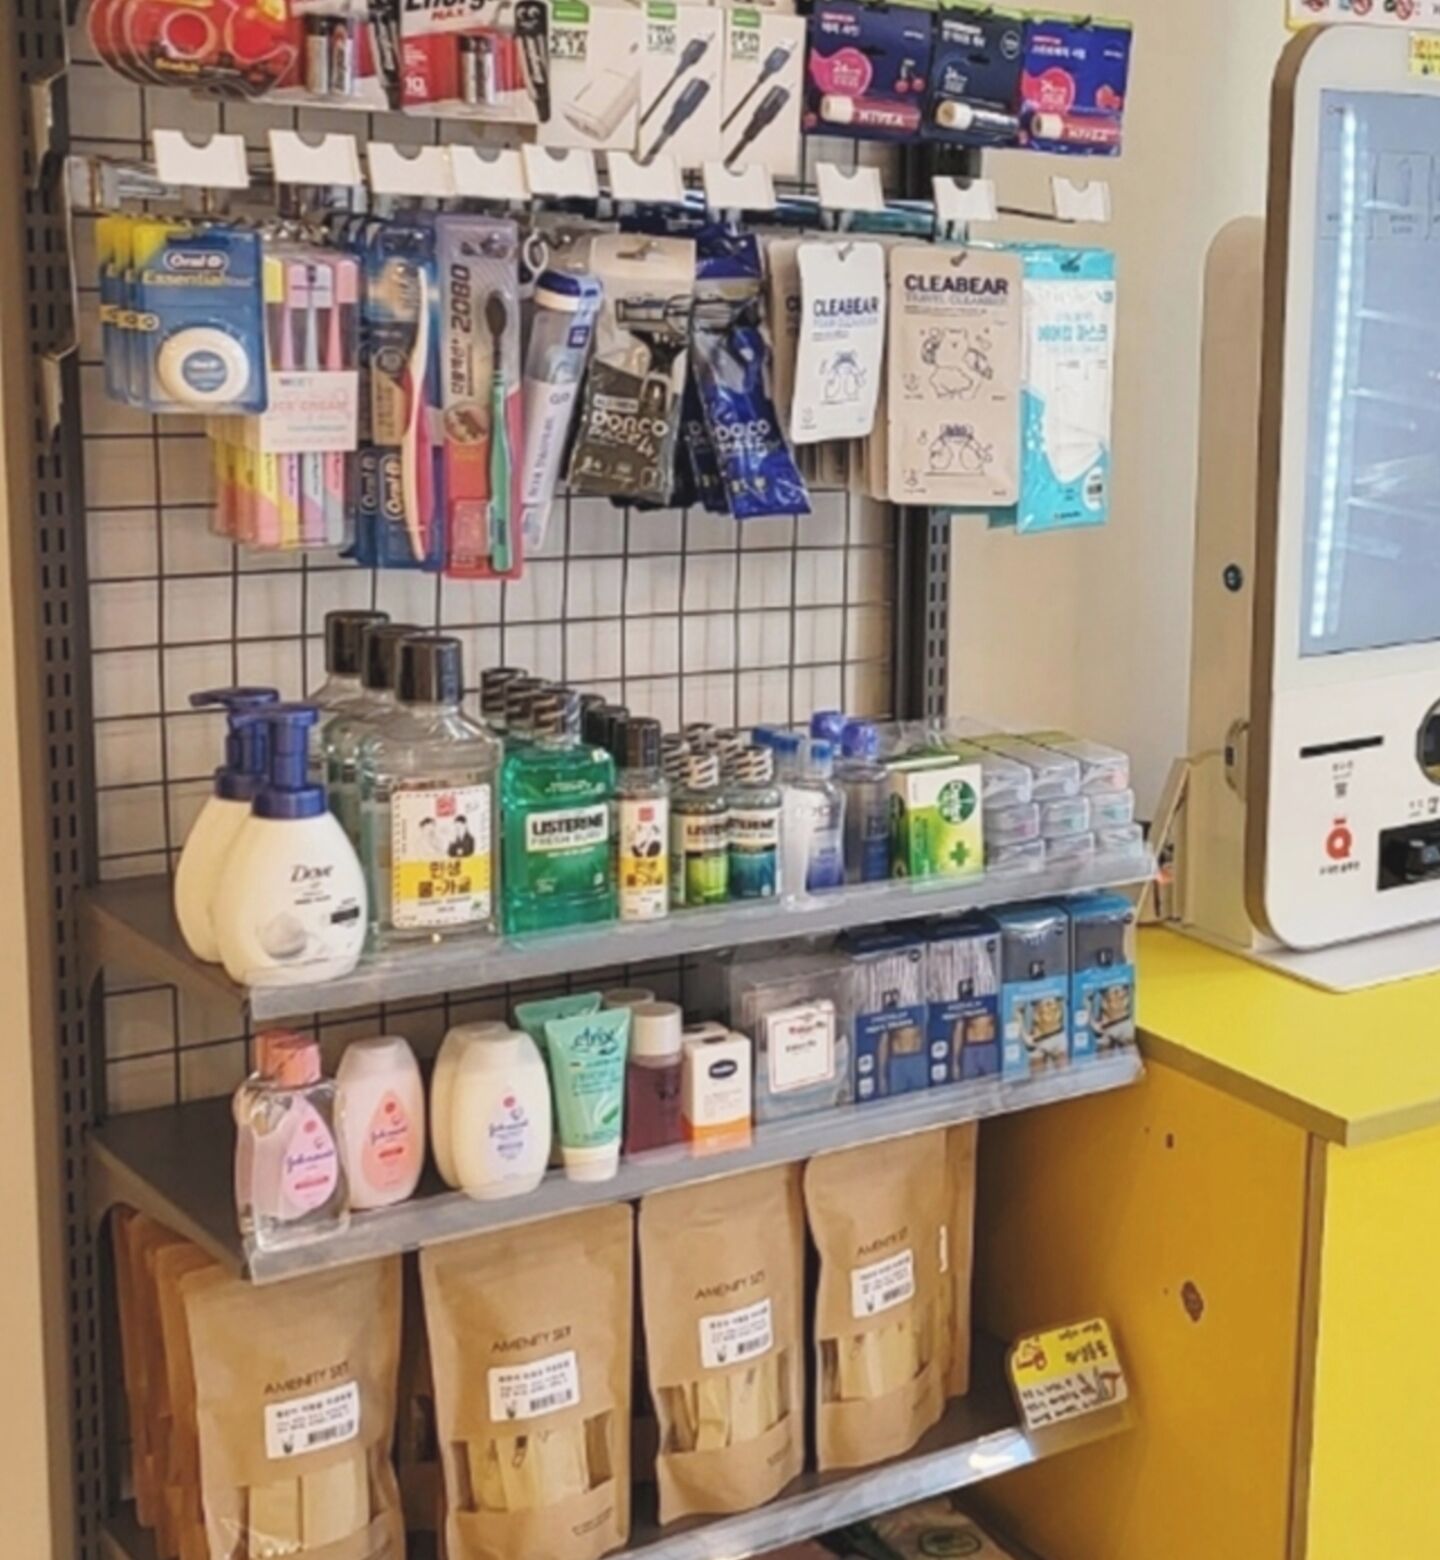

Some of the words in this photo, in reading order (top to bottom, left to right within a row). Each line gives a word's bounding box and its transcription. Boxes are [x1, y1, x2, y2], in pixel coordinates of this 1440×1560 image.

[904, 274, 1009, 295] CLEABEAR
[451, 264, 472, 334] 2080
[813, 297, 878, 317] CLEABEAR
[532, 813, 604, 836] LISTERINE
[291, 864, 334, 883] Dove
[263, 1368, 327, 1395] AMENITY
